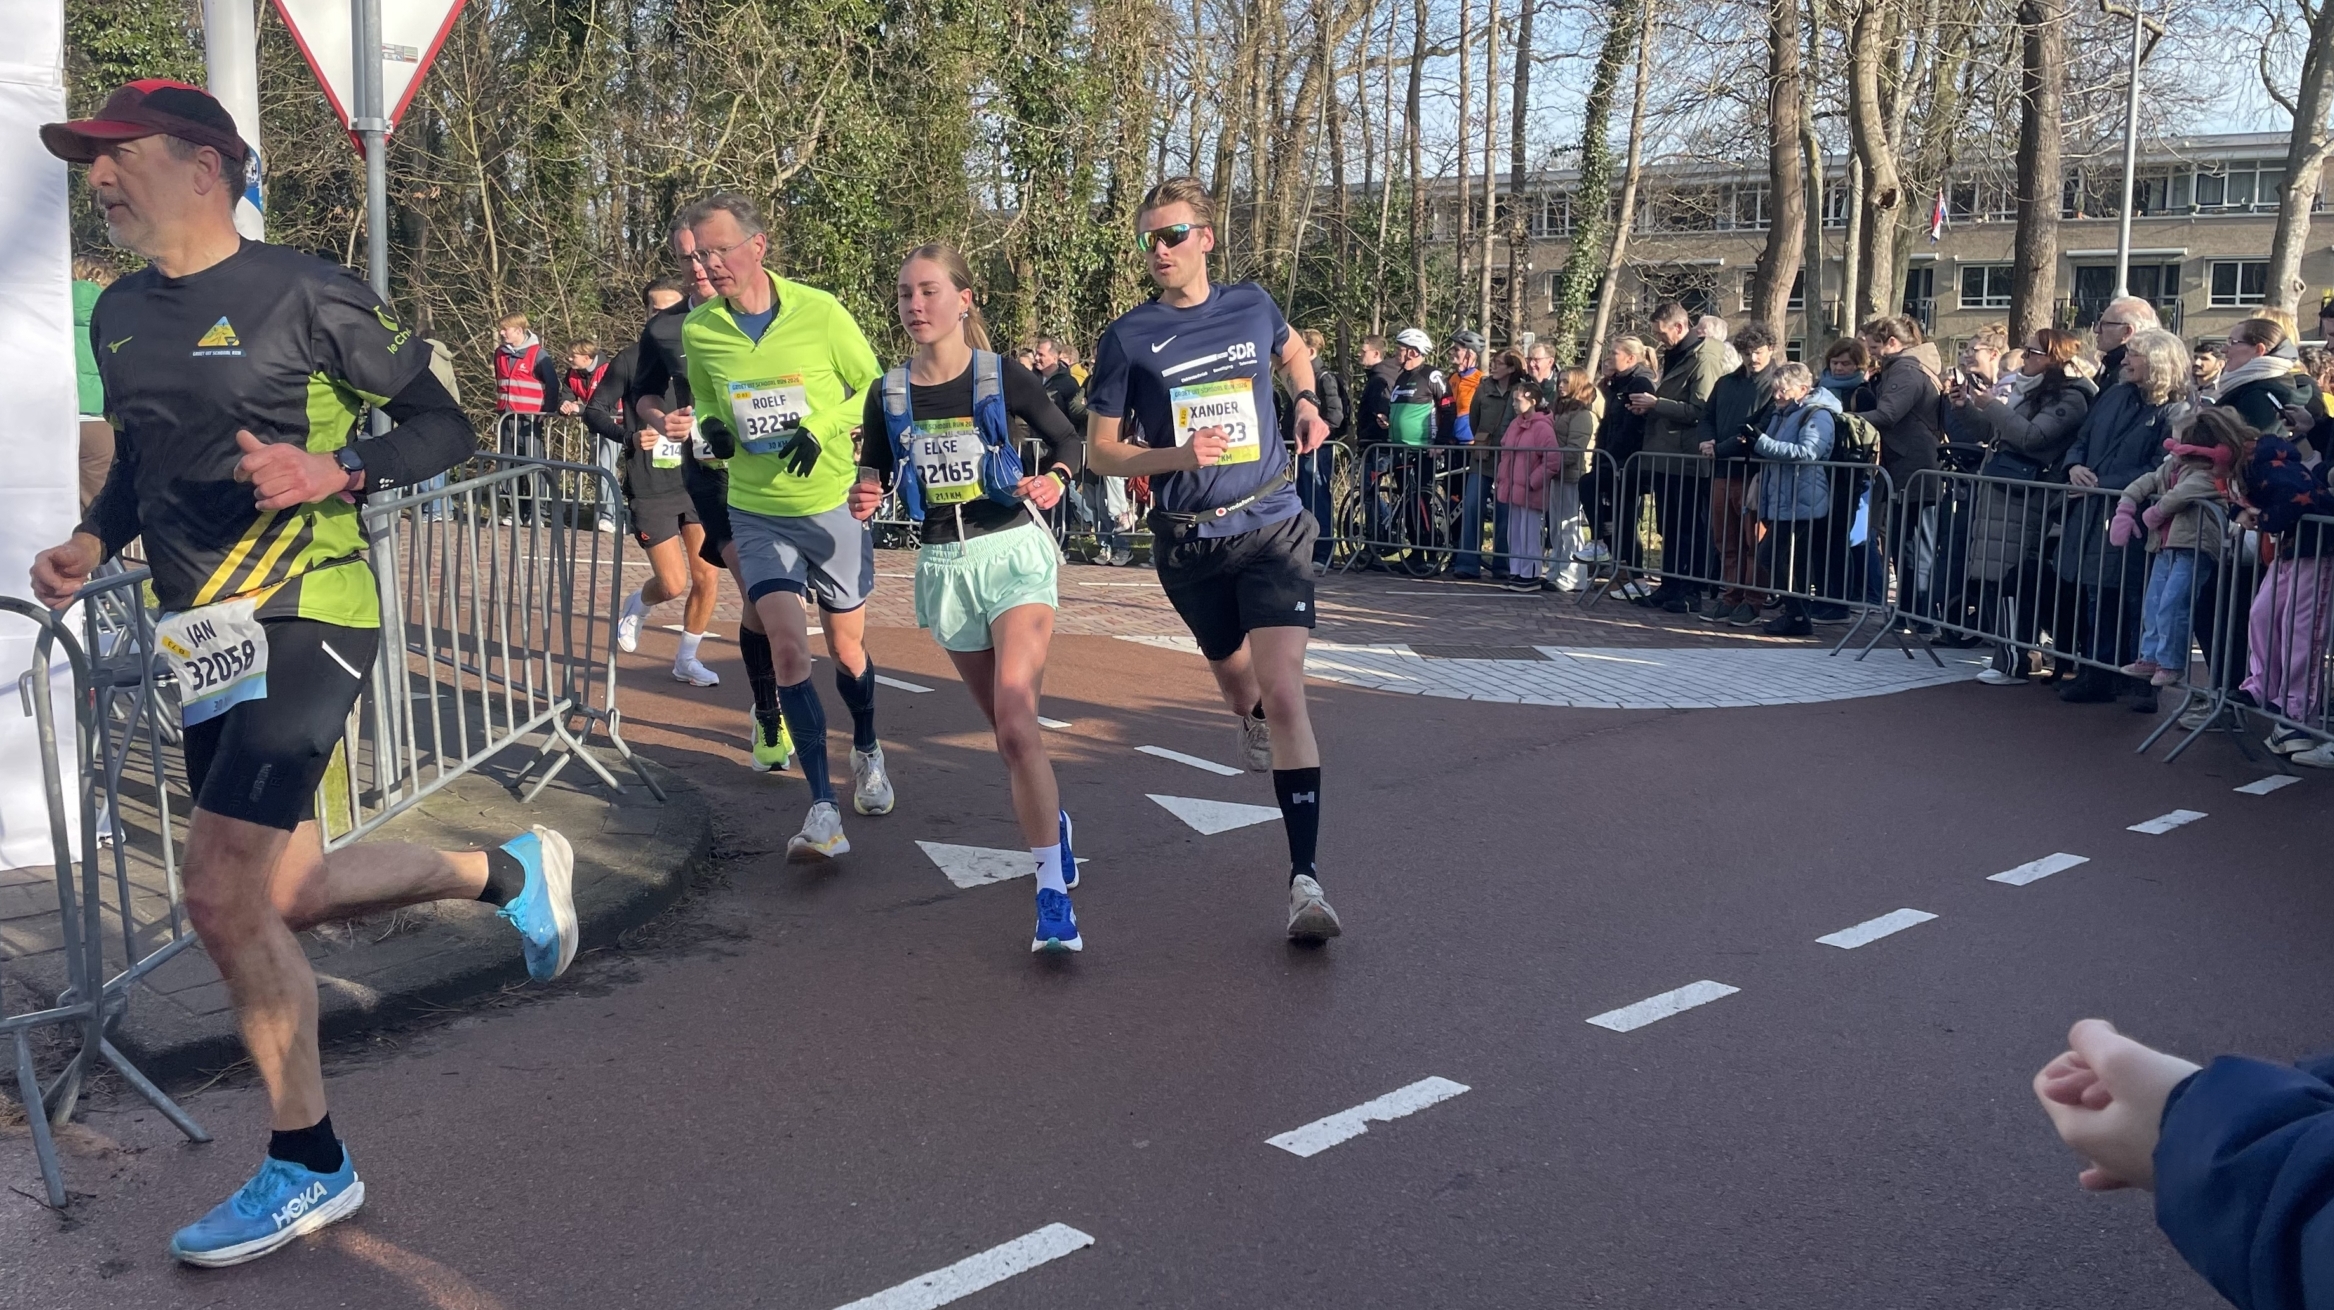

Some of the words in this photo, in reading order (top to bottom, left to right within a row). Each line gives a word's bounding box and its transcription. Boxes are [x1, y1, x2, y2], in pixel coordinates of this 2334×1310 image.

[1227, 341, 1256, 362] SDR
[752, 394, 787, 410] ROELF
[1189, 401, 1239, 419] XANDER
[768, 441, 776, 450] 30
[1221, 454, 1233, 462] KM
[950, 491, 962, 499] KM
[1227, 495, 1255, 512] vodafone
[184, 639, 255, 691] 32058
[271, 1180, 328, 1231] HOKA
